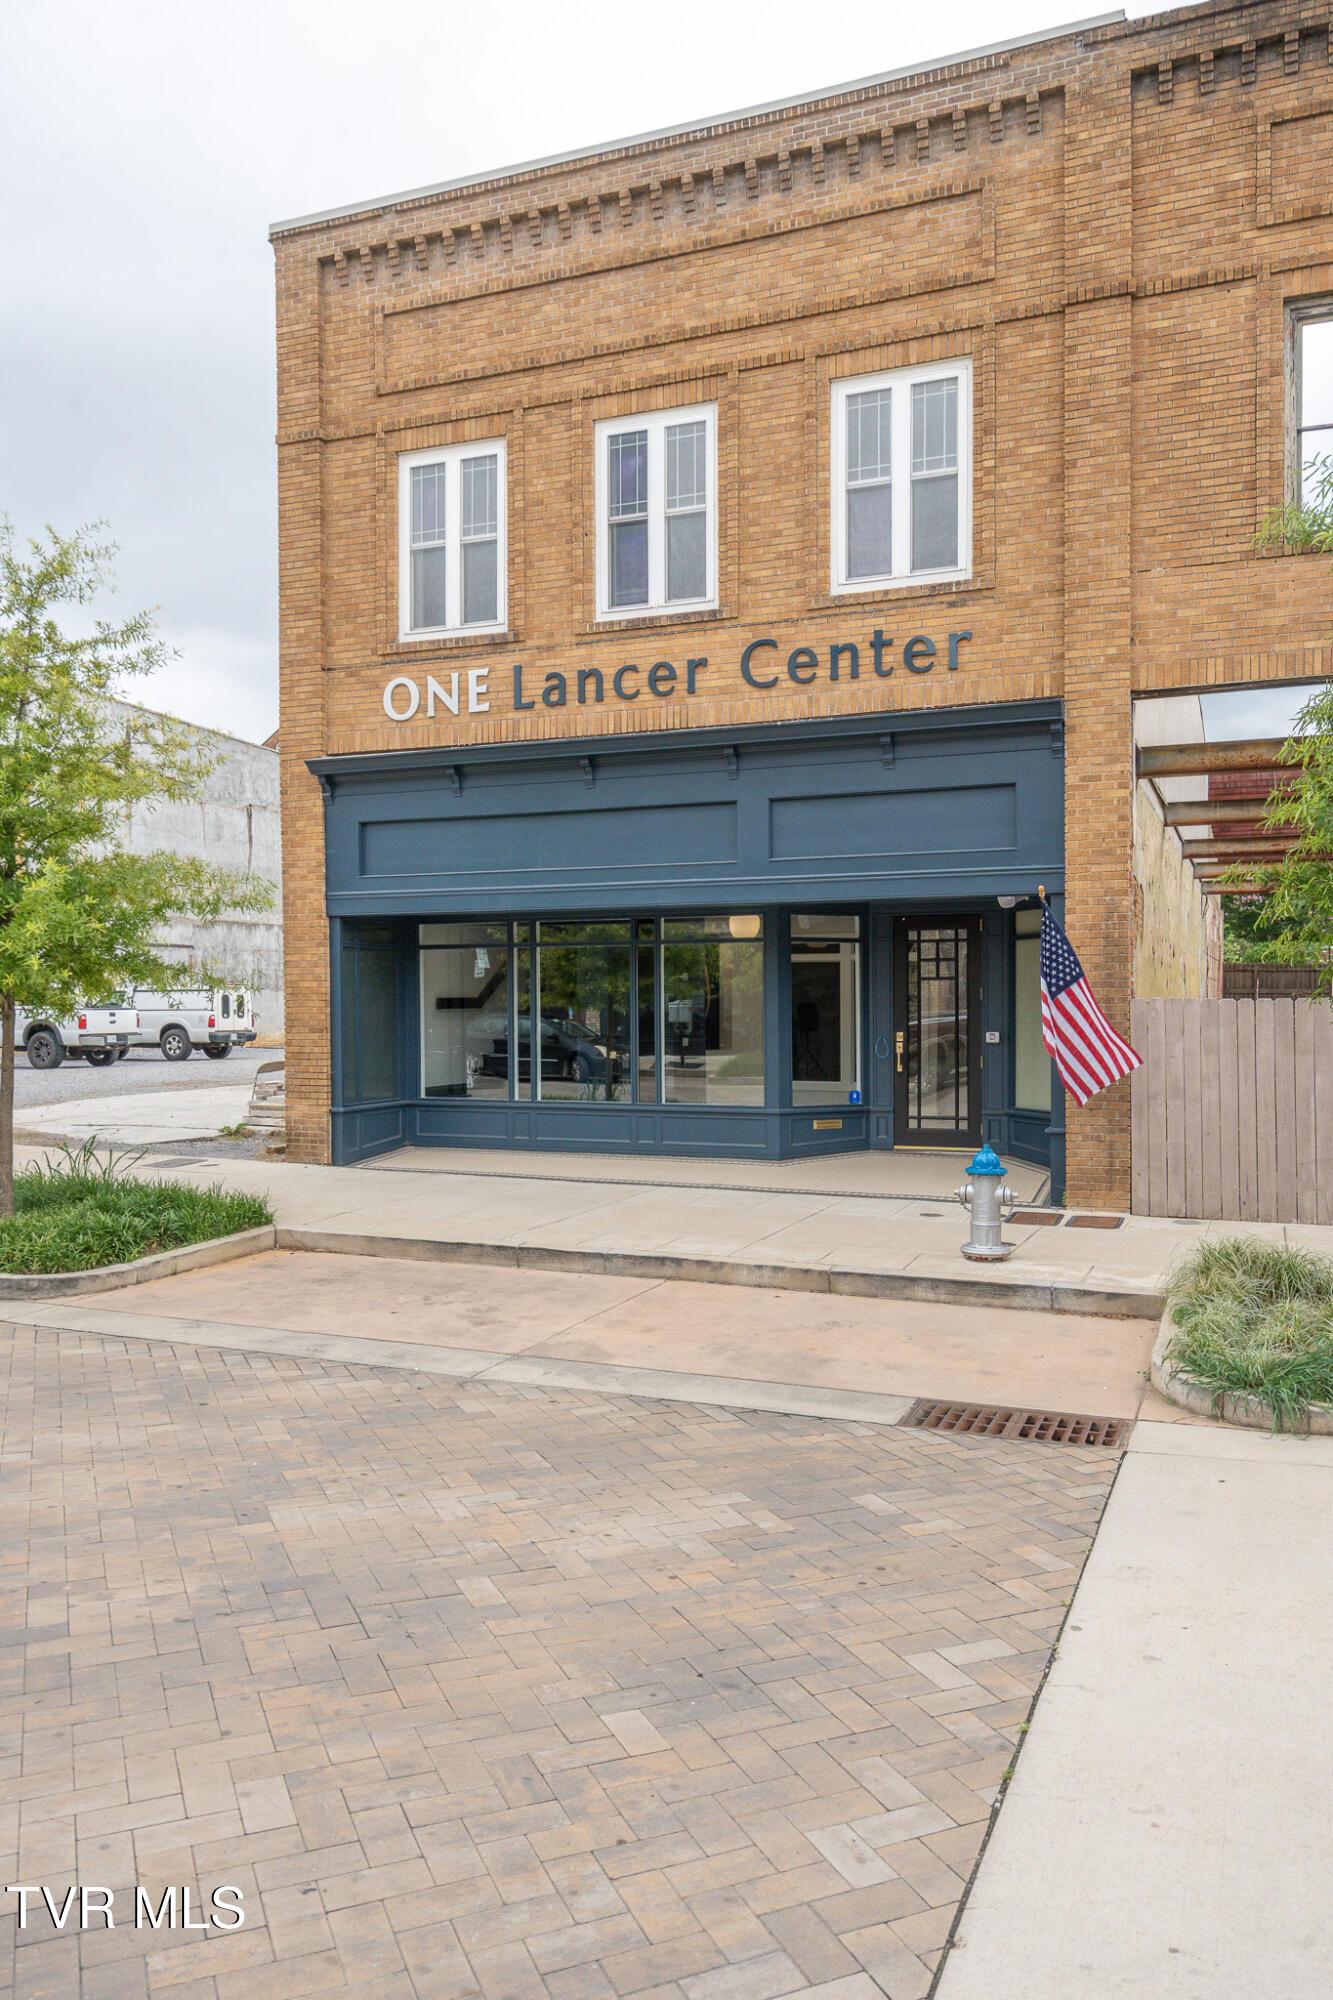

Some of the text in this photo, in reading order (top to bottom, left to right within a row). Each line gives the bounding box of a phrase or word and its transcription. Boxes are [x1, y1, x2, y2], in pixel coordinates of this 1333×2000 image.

[383, 629, 973, 721] ONE Lancer Center
